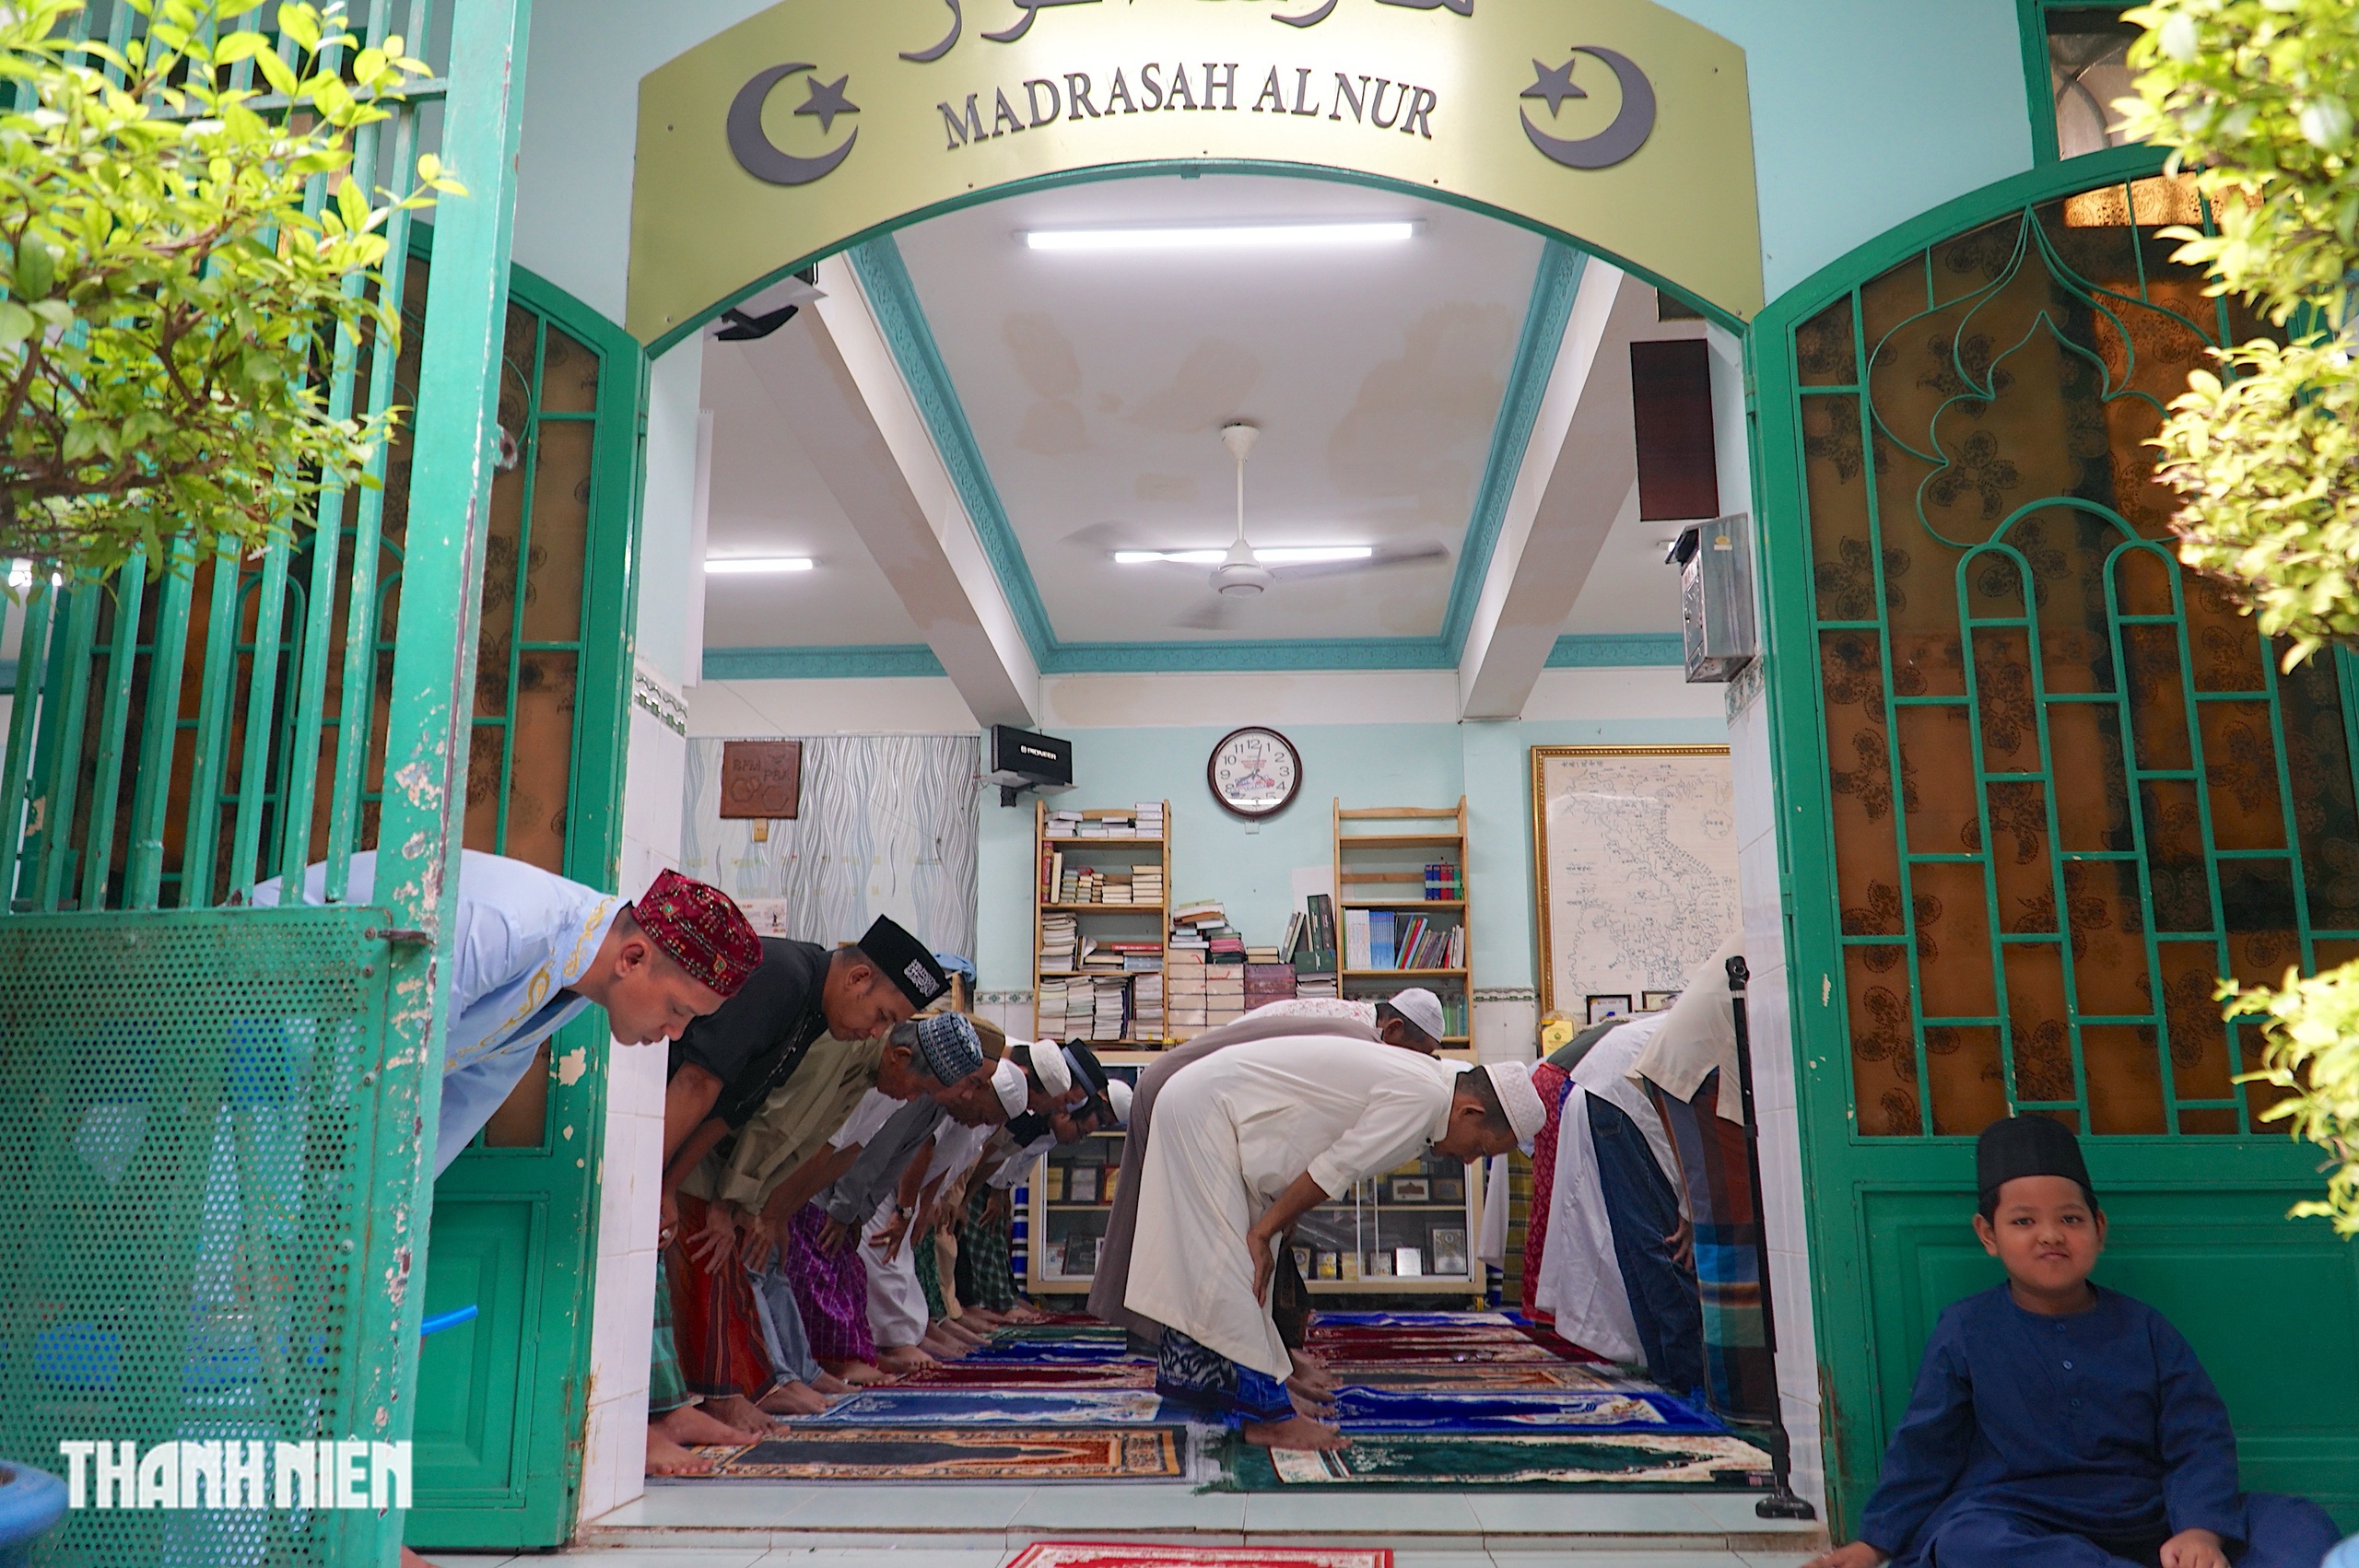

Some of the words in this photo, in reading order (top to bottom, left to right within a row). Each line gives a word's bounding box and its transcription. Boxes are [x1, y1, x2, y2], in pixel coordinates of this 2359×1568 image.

[936, 62, 1238, 149] MADRASAH
[1252, 64, 1320, 116] AL
[1329, 72, 1438, 139] NUR
[1235, 743, 1244, 754] 11
[1247, 739, 1261, 750] 12
[1027, 747, 1057, 760] PIONEER
[1274, 752, 1285, 763] 2
[1224, 755, 1237, 766] 10
[1220, 769, 1231, 780] 9
[1279, 766, 1290, 777] 3
[1225, 783, 1235, 794] 8
[1276, 780, 1285, 790] 4
